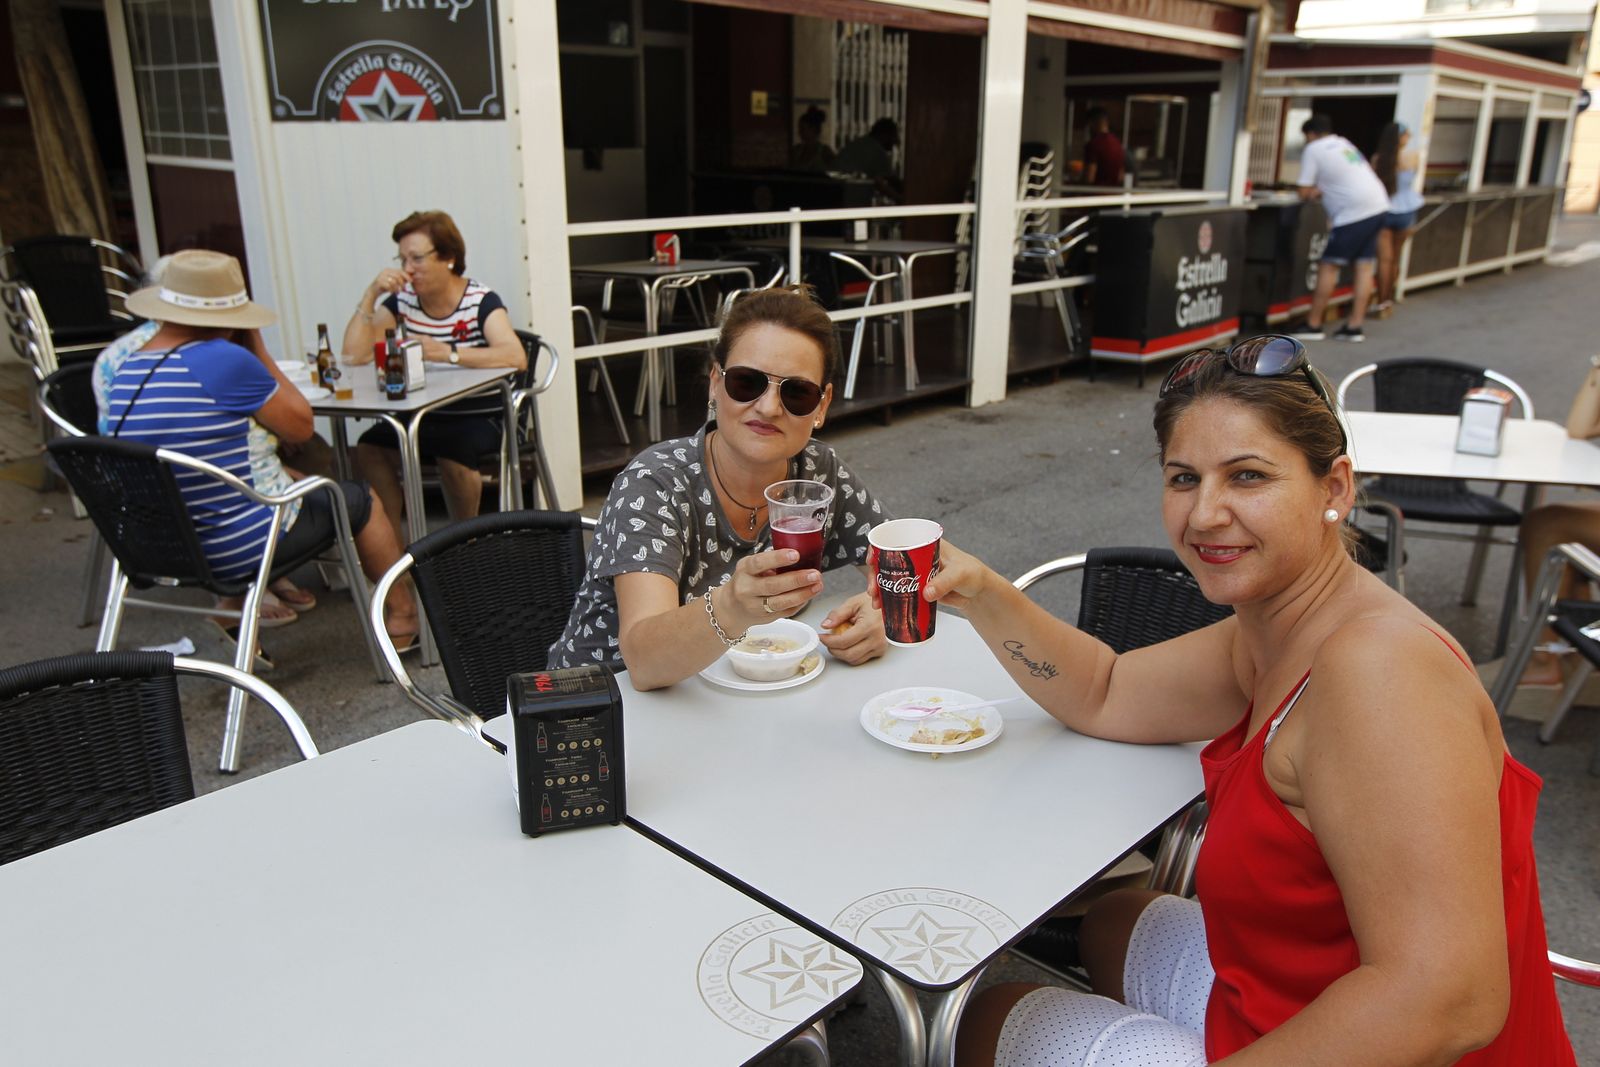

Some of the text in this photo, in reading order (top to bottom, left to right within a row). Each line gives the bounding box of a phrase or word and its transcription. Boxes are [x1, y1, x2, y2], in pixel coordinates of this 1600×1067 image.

[327, 53, 444, 105] Estrella Galicia
[1176, 252, 1228, 290] Estrella
[1176, 287, 1222, 328] Galicia
[876, 573, 921, 593] Coca-Cola
[839, 891, 1007, 930] Estrella Galicia
[704, 918, 777, 1035] Estrella Galicia
